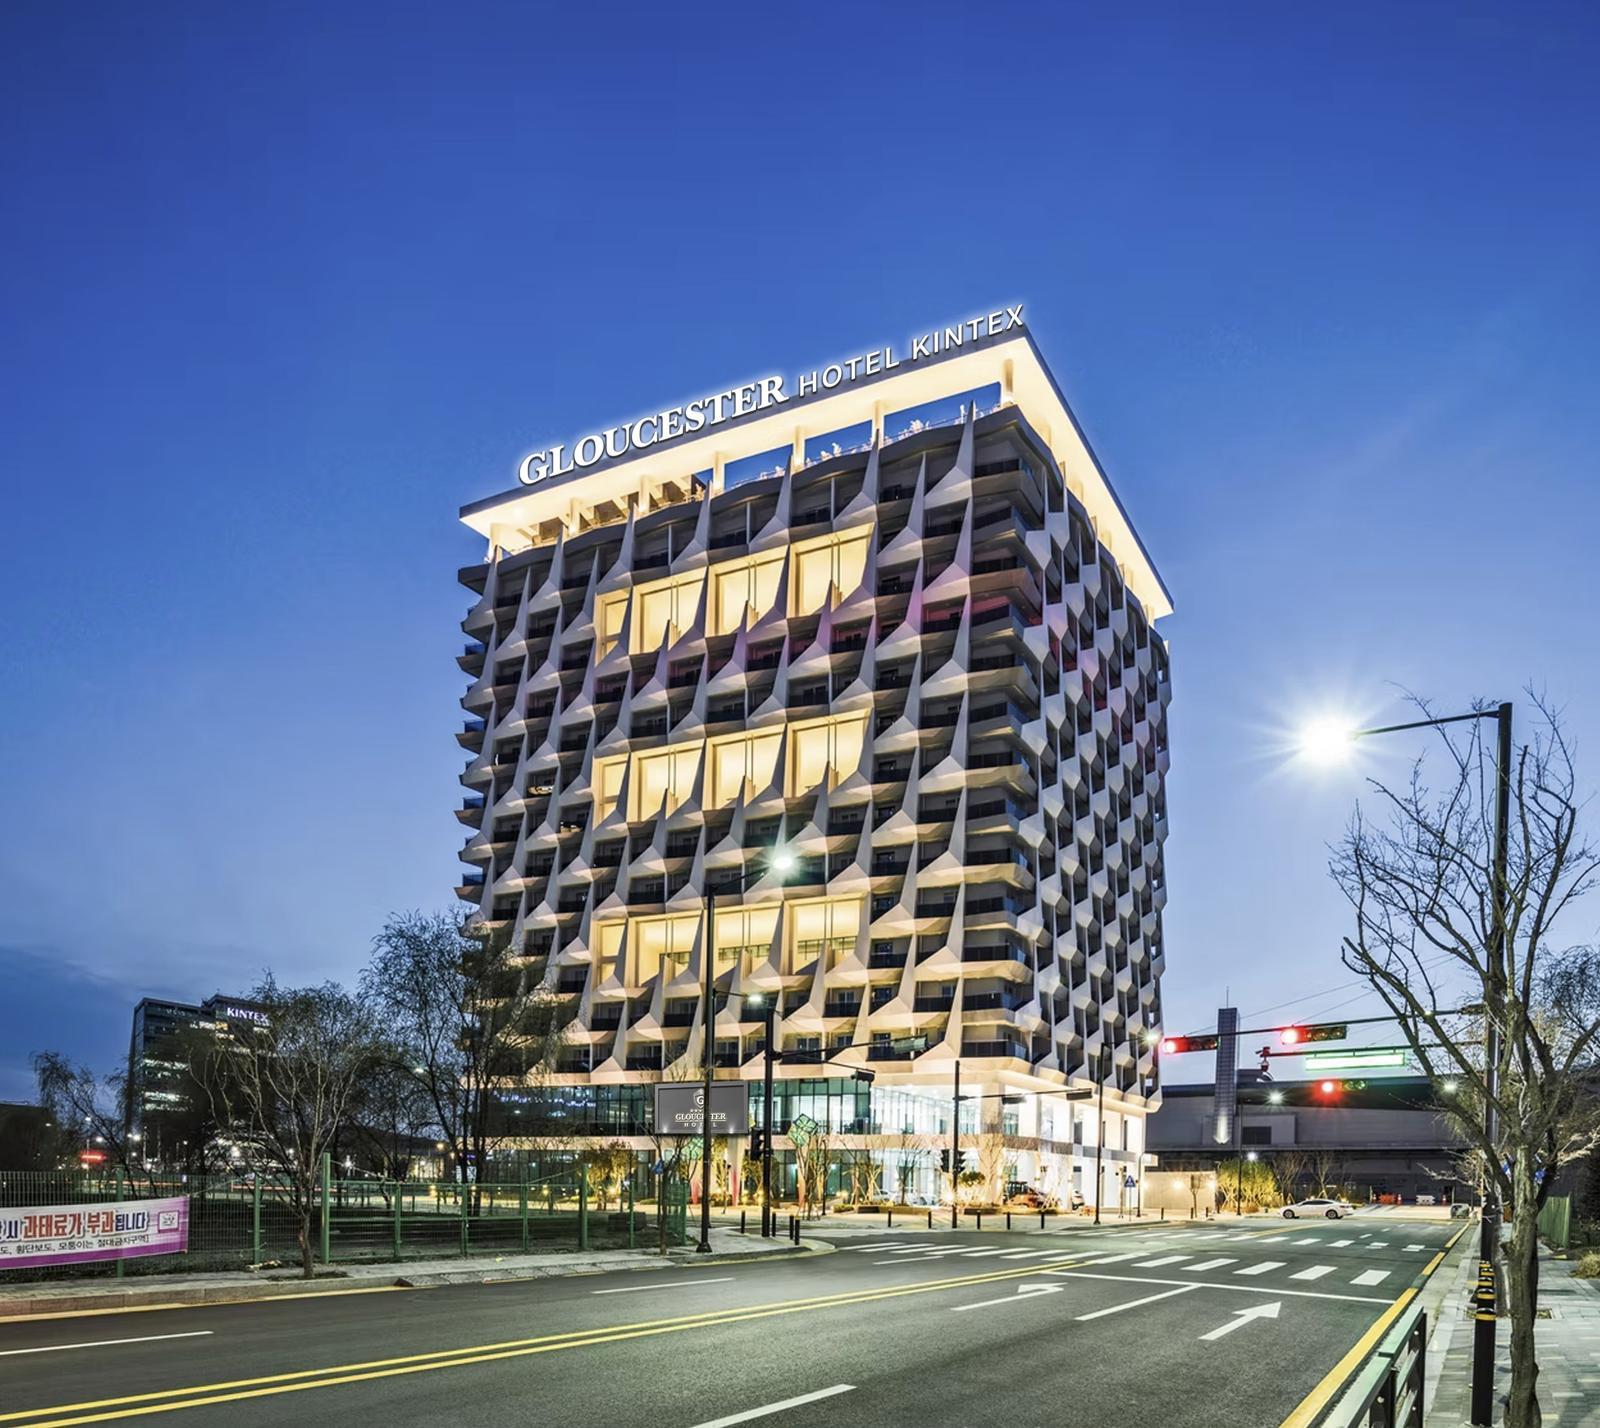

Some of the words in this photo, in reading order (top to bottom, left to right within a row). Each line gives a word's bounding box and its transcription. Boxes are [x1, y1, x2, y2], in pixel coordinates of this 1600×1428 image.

[519, 374, 789, 486] GLOUCESTER
[799, 346, 900, 398] HOTEL
[912, 303, 1024, 361] KINTEX
[227, 1007, 268, 1021] KINTEX
[675, 1113, 726, 1121] GLOUCTER
[23, 1212, 82, 1239] 과태료가
[87, 1210, 147, 1234] 부과됩니다
